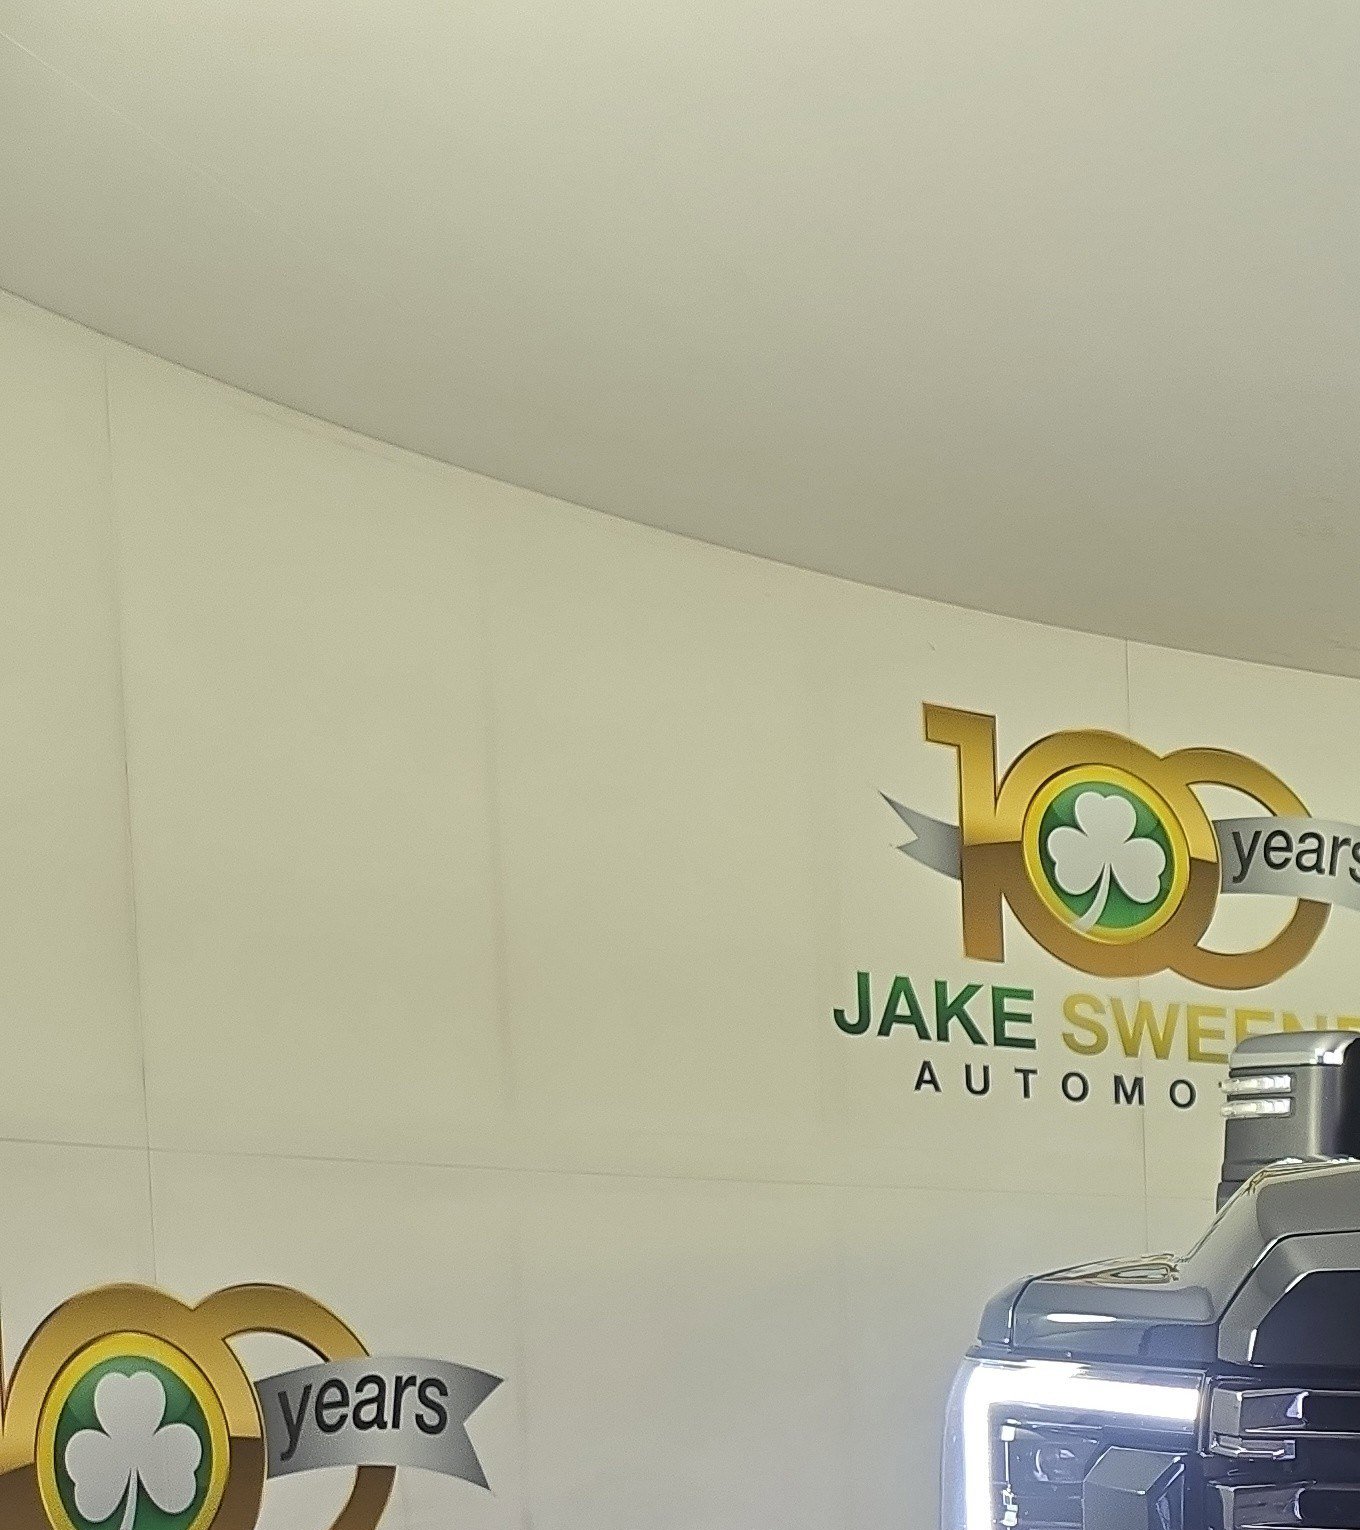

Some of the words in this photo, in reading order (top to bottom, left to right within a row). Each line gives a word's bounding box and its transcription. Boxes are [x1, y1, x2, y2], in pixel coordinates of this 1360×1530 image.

[834, 971, 1037, 1052] JAKE
[915, 1061, 1197, 1109] AUTOMO
[278, 1373, 449, 1462] years
